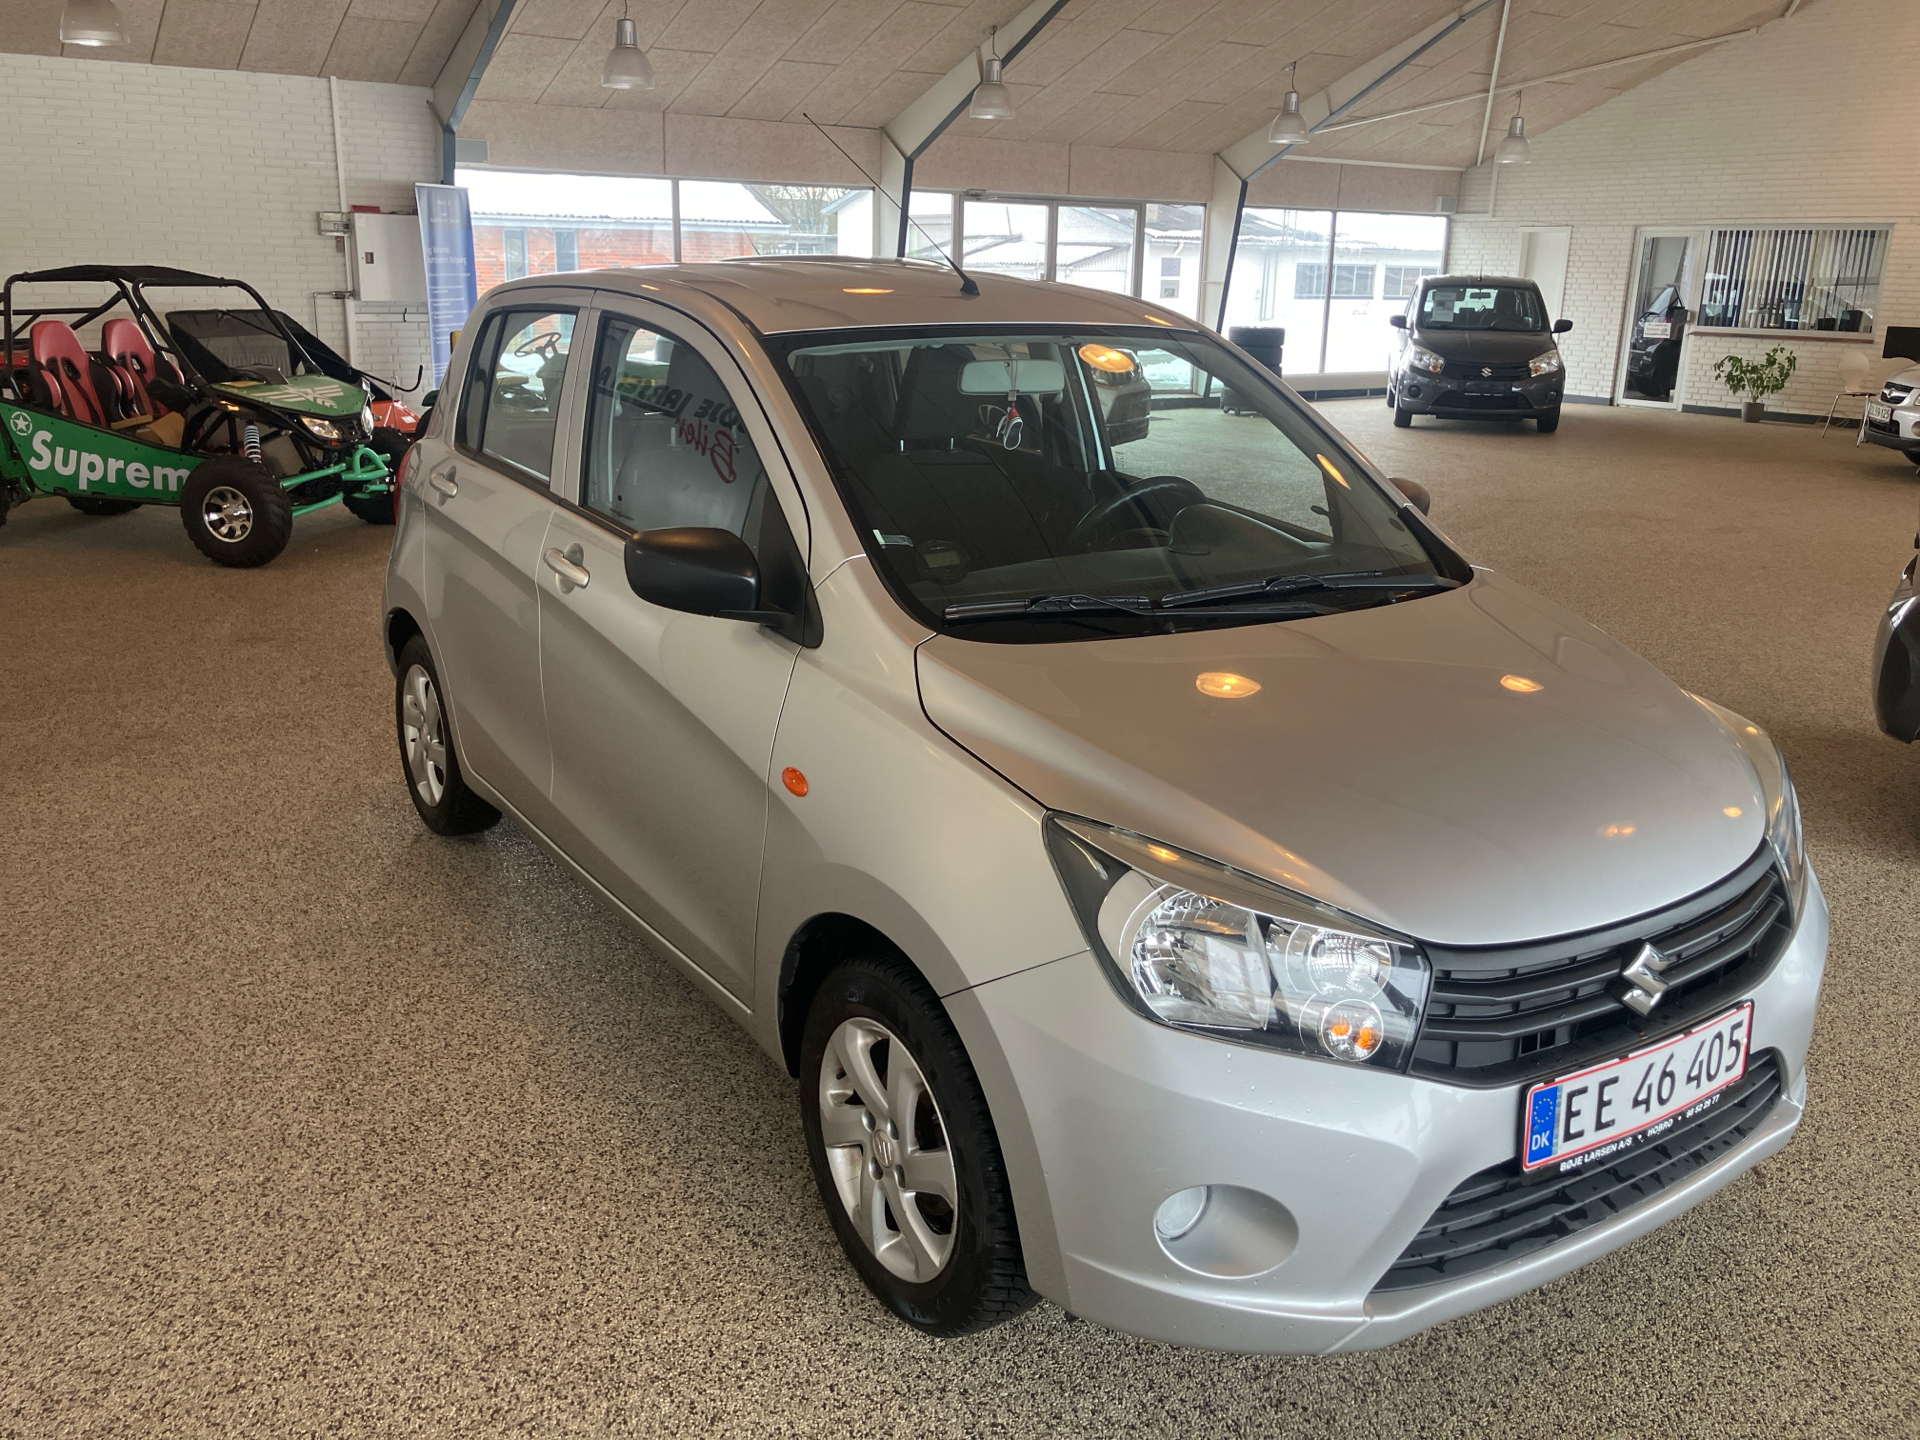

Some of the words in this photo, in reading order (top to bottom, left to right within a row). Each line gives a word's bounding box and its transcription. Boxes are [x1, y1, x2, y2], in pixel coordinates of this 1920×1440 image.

[1562, 1075, 1620, 1143] EE
[1631, 1052, 1676, 1114] 46
[1685, 1019, 1744, 1089] 405
[1531, 1130, 1550, 1151] DK
[1559, 1156, 1583, 1172] BØJE
[1584, 1143, 1617, 1163] LARSEN
[1617, 1136, 1632, 1150] A/S
[1647, 1118, 1674, 1137] HOBRO
